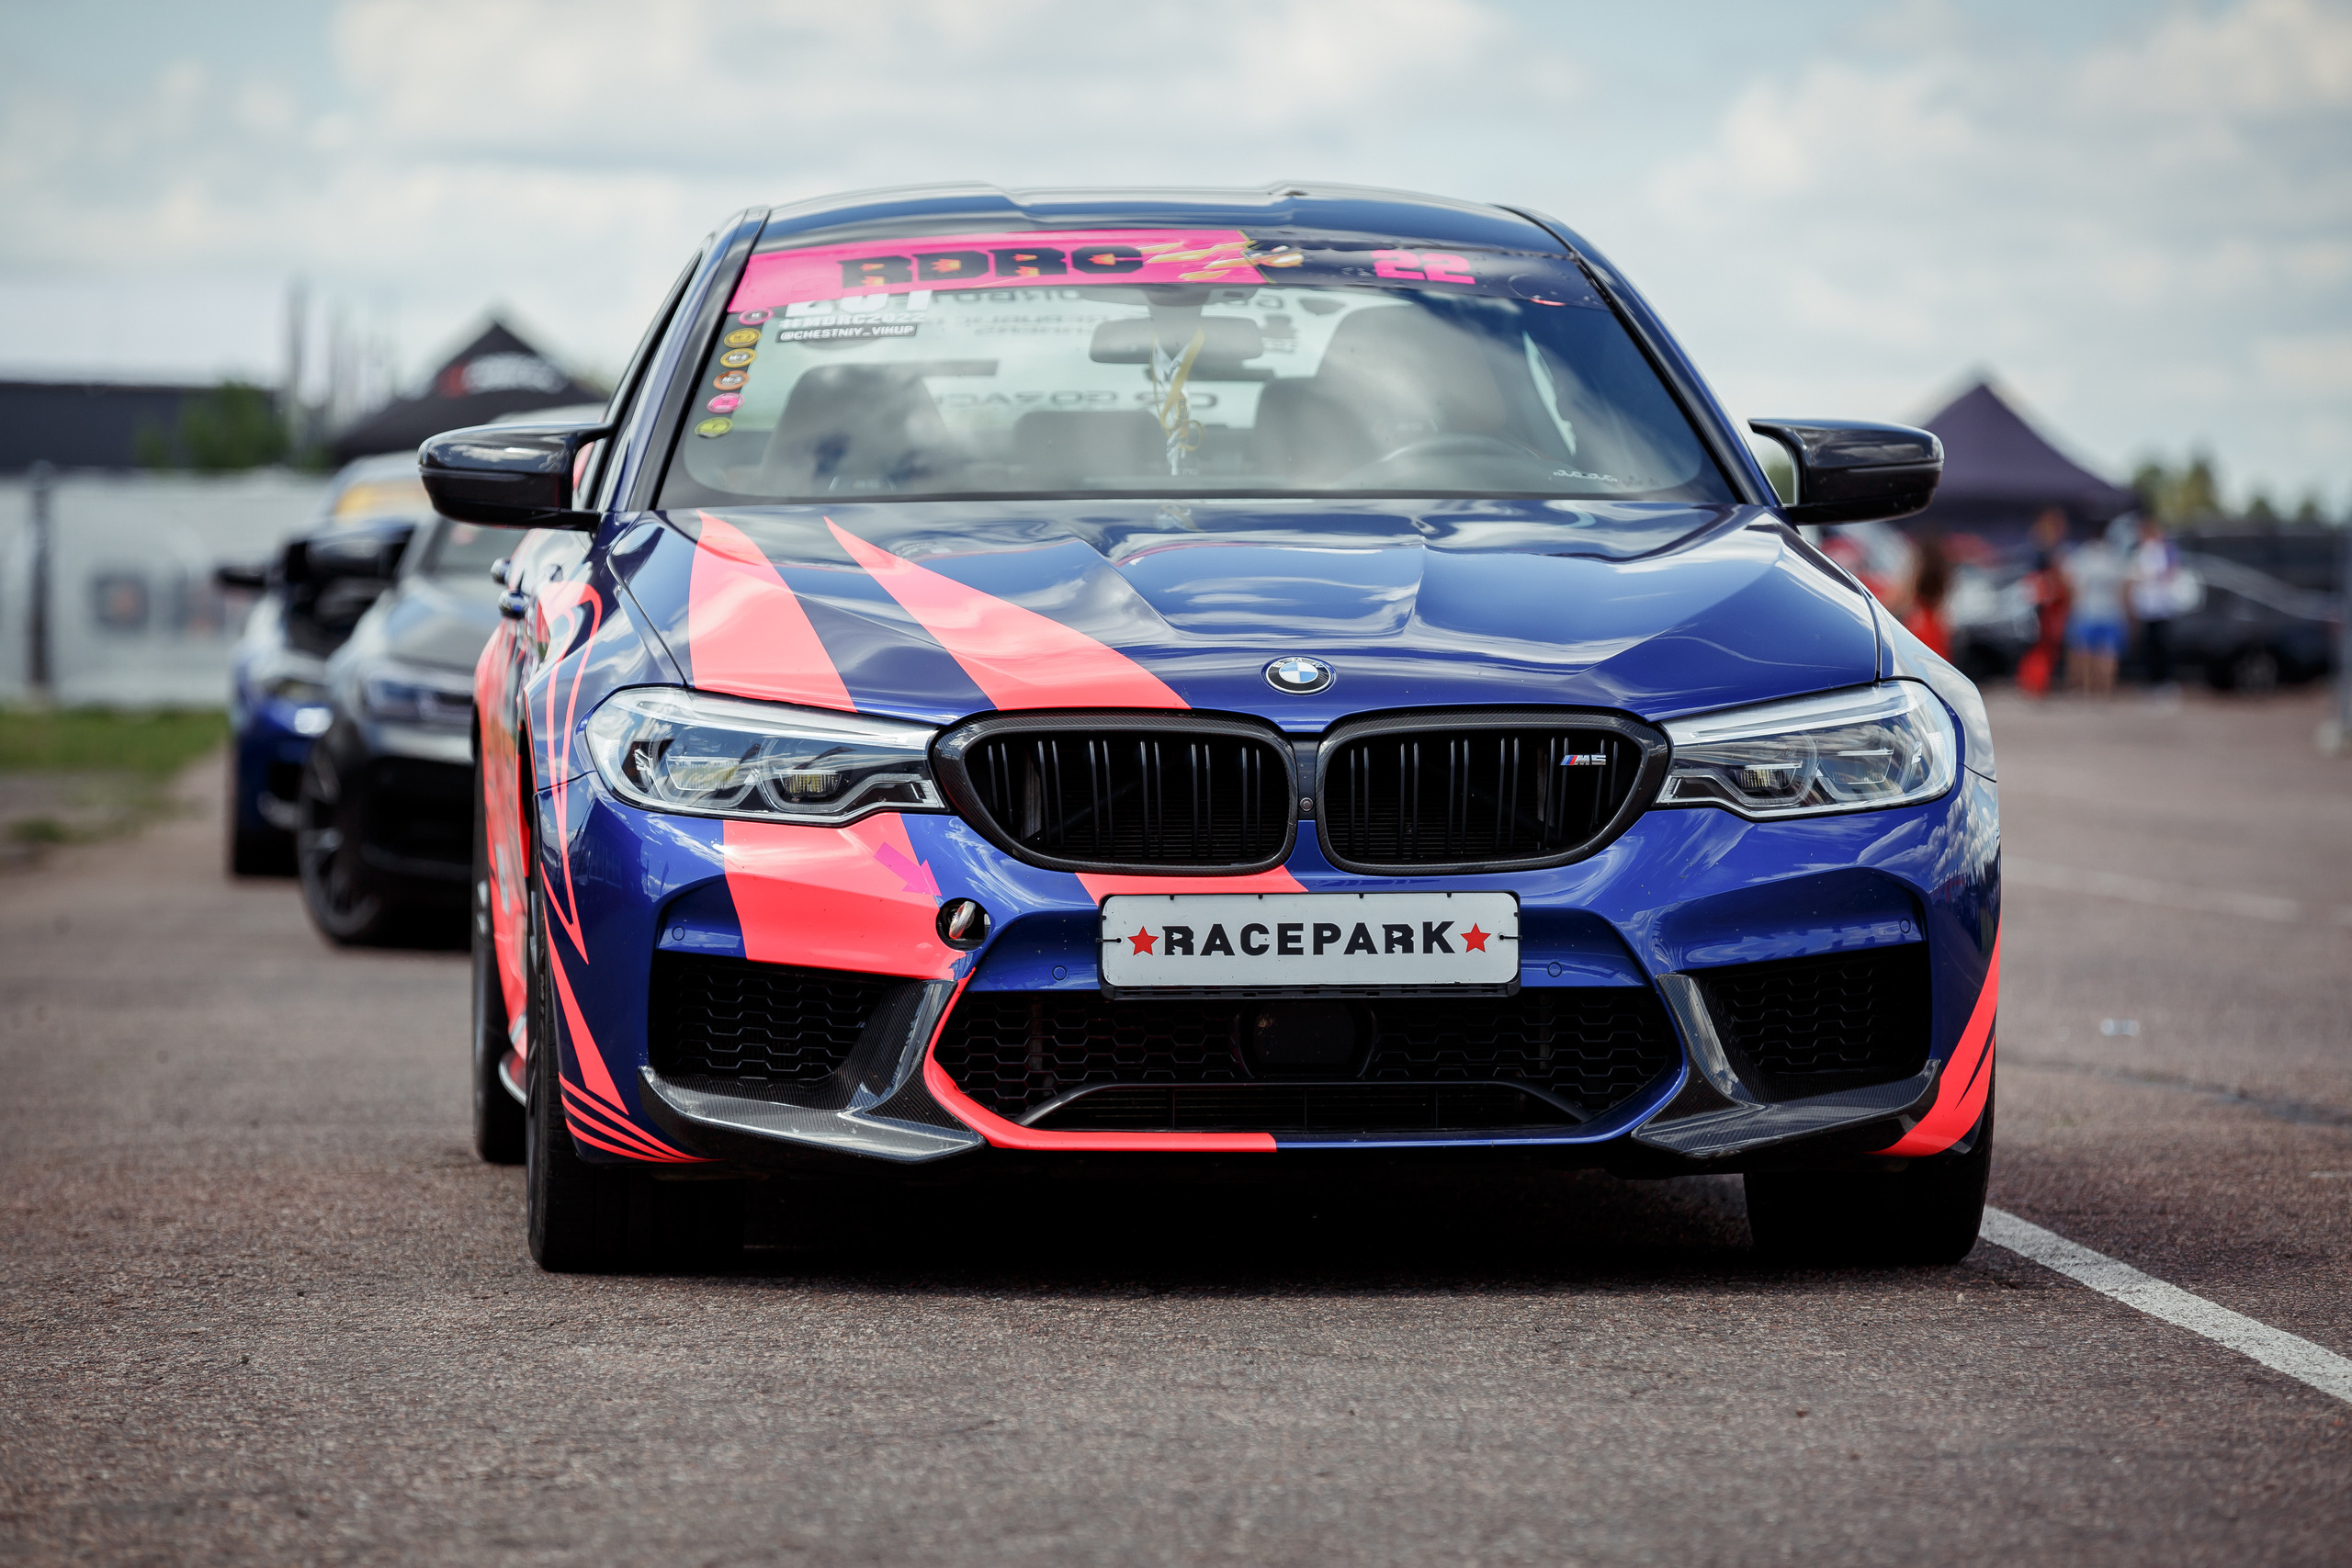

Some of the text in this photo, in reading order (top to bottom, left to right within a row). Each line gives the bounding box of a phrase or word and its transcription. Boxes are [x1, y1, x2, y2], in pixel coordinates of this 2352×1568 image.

[837, 245, 1144, 288] RDRC
[1370, 249, 1476, 285] 22
[1573, 754, 1607, 766] M5
[1162, 921, 1456, 956] RACEPARK
